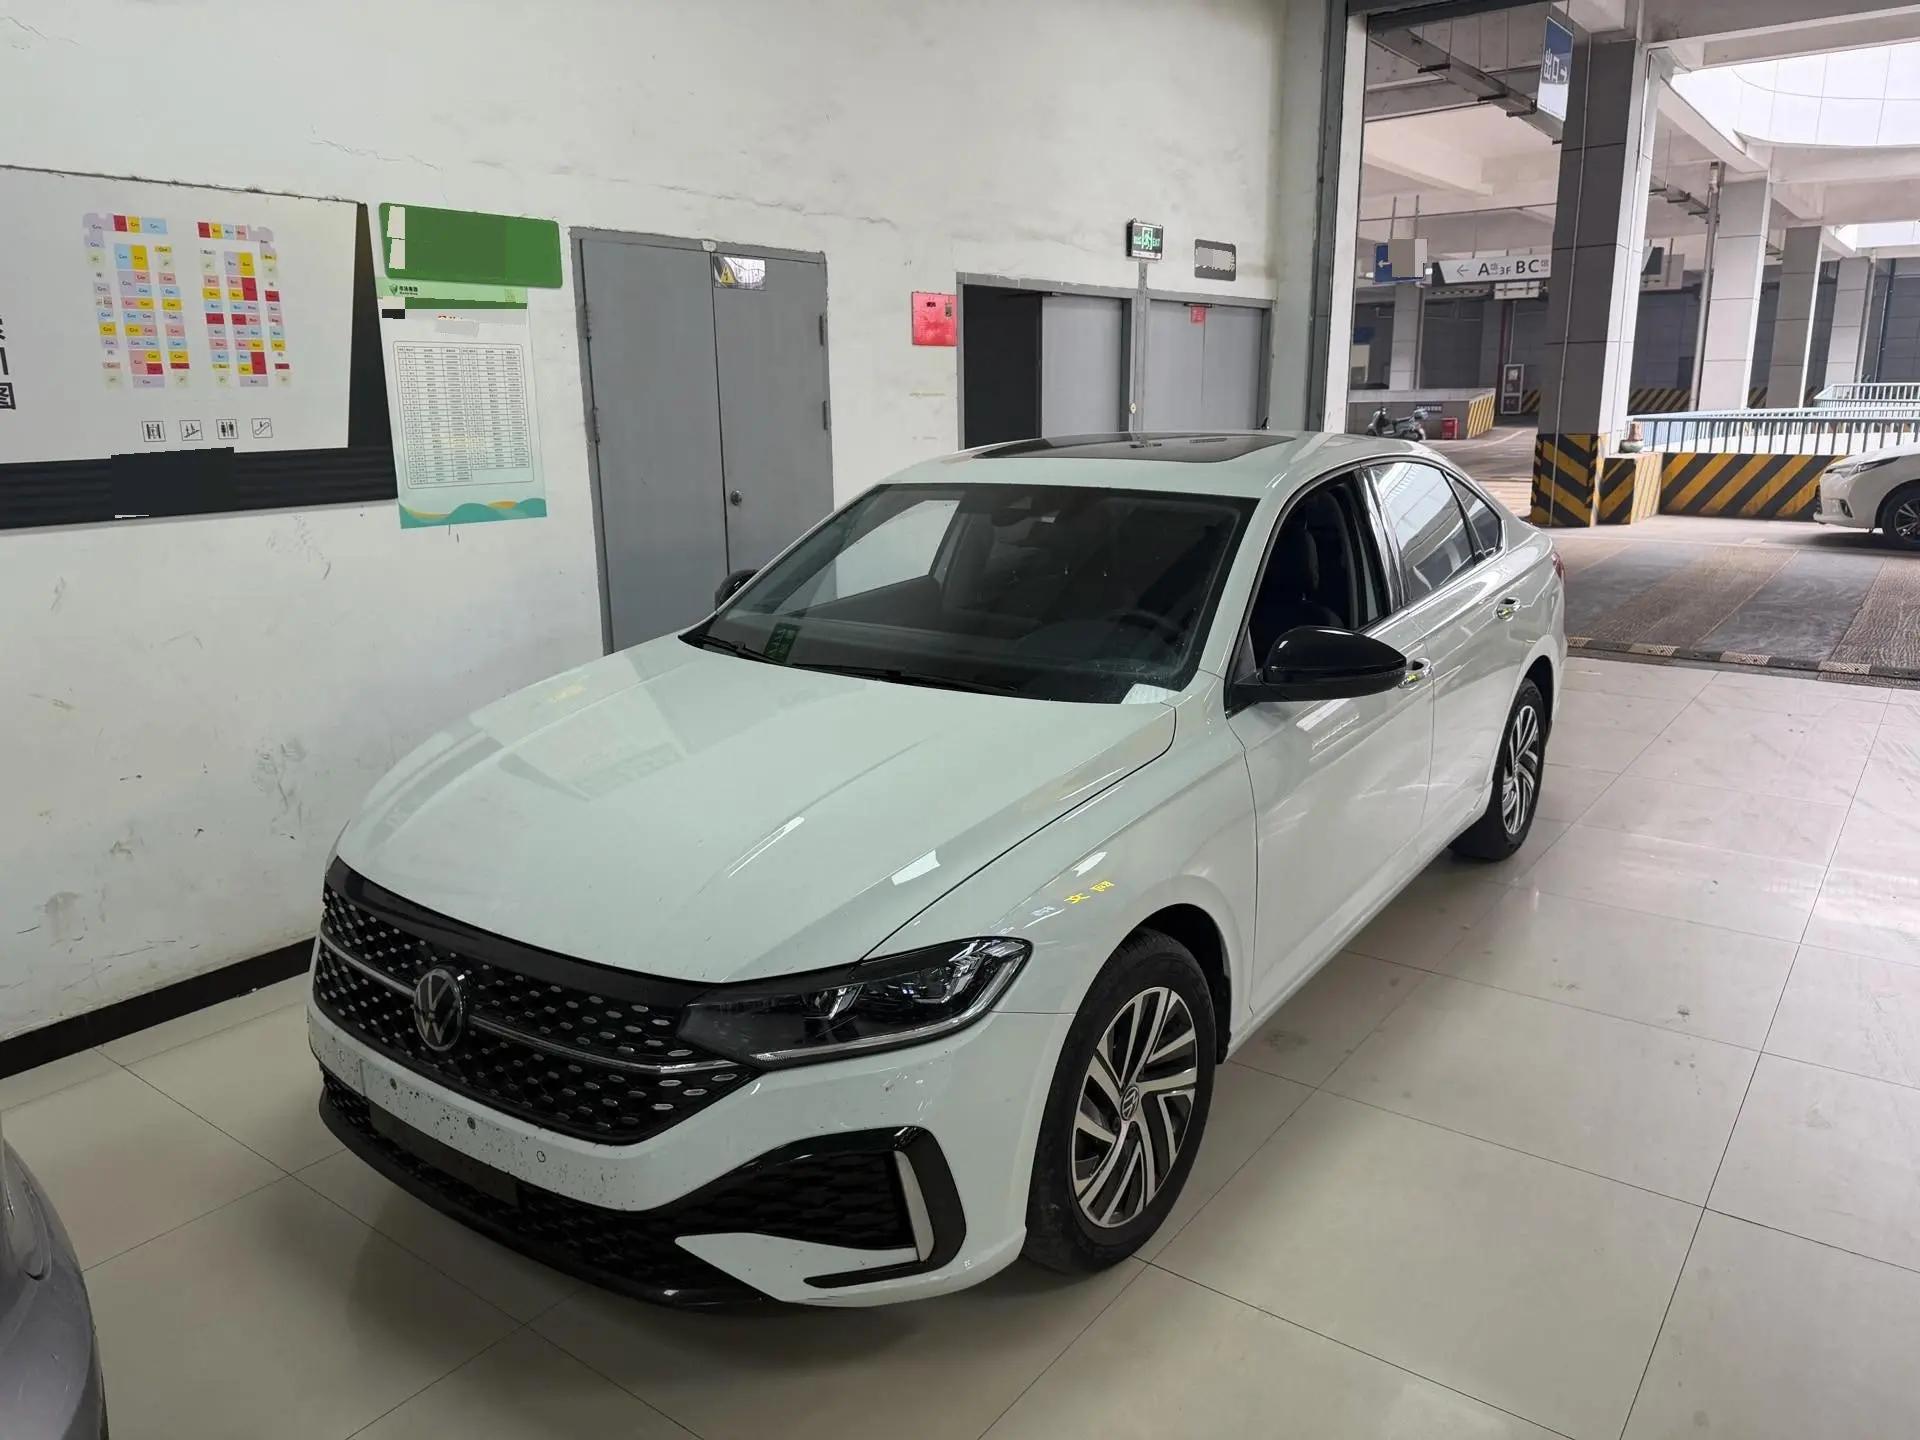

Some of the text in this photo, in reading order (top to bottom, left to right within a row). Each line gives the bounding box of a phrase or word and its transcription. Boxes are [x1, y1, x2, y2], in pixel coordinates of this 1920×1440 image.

[1543, 47, 1560, 84] 出口
[1478, 262, 1490, 276] A
[1499, 265, 1512, 276] 3F
